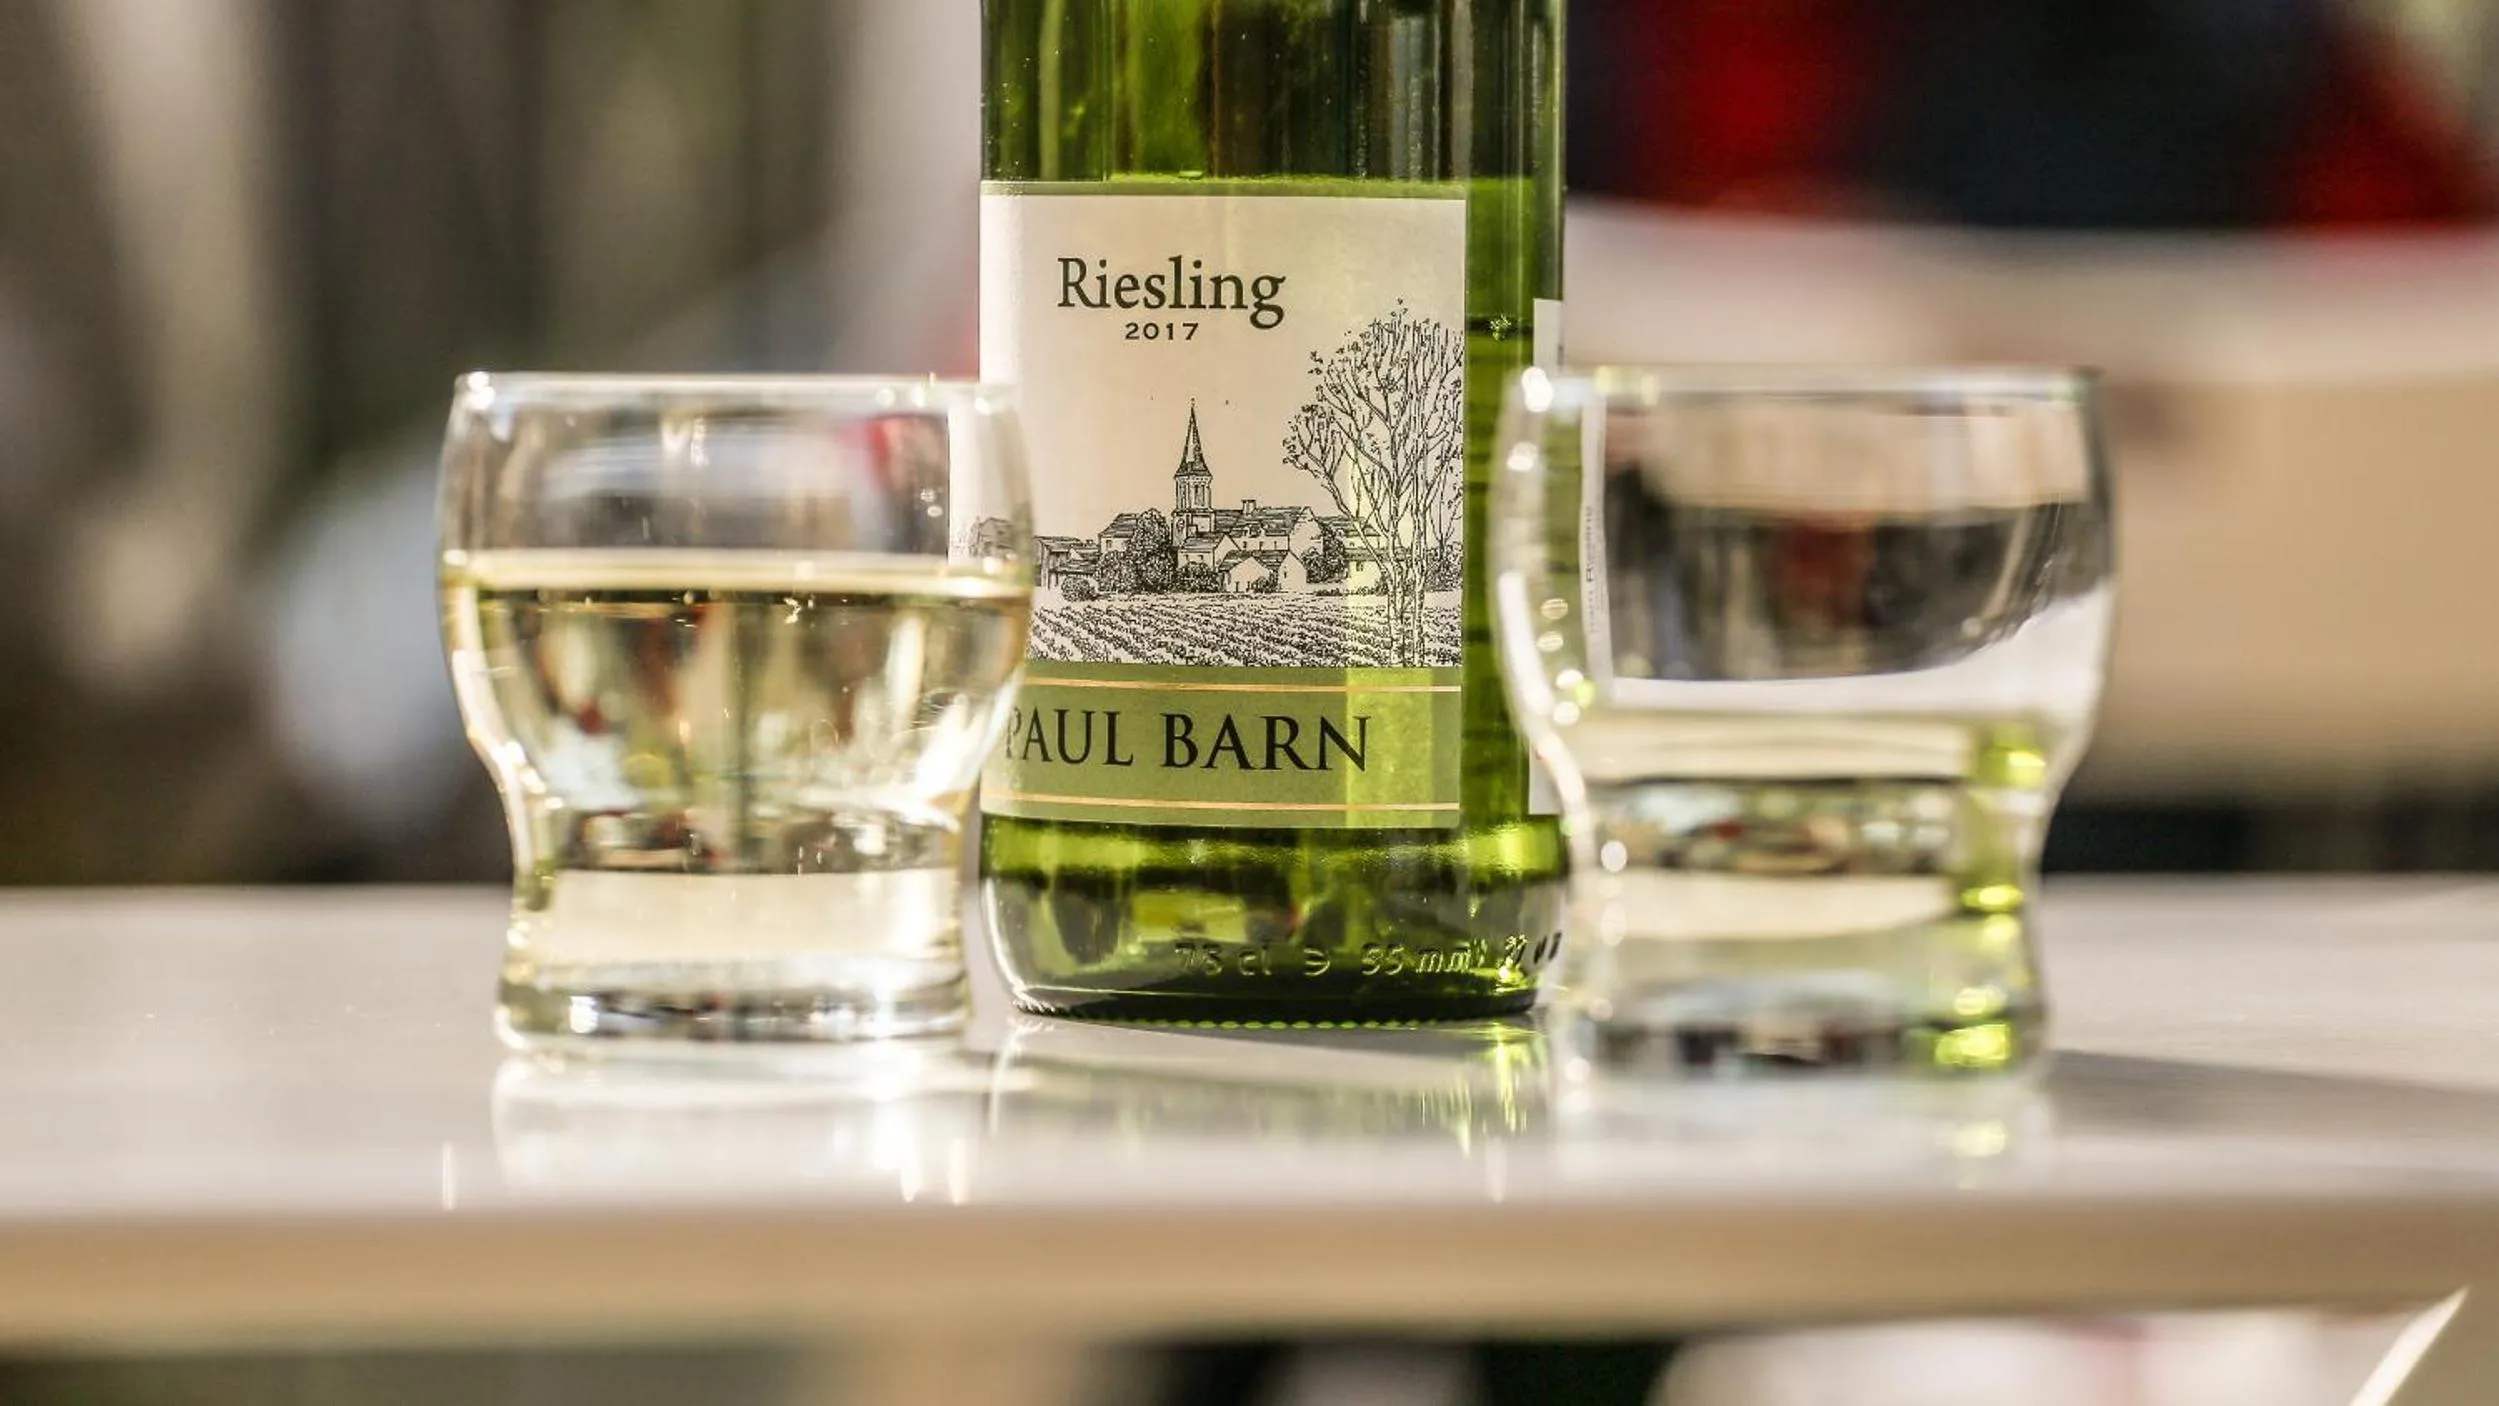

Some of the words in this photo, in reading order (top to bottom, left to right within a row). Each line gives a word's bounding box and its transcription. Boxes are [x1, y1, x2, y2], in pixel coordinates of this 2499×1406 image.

[1056, 254, 1286, 330] Riesling
[1125, 322, 1199, 341] 2017
[1004, 706, 1135, 767] PAUL
[1160, 712, 1372, 772] BARN
